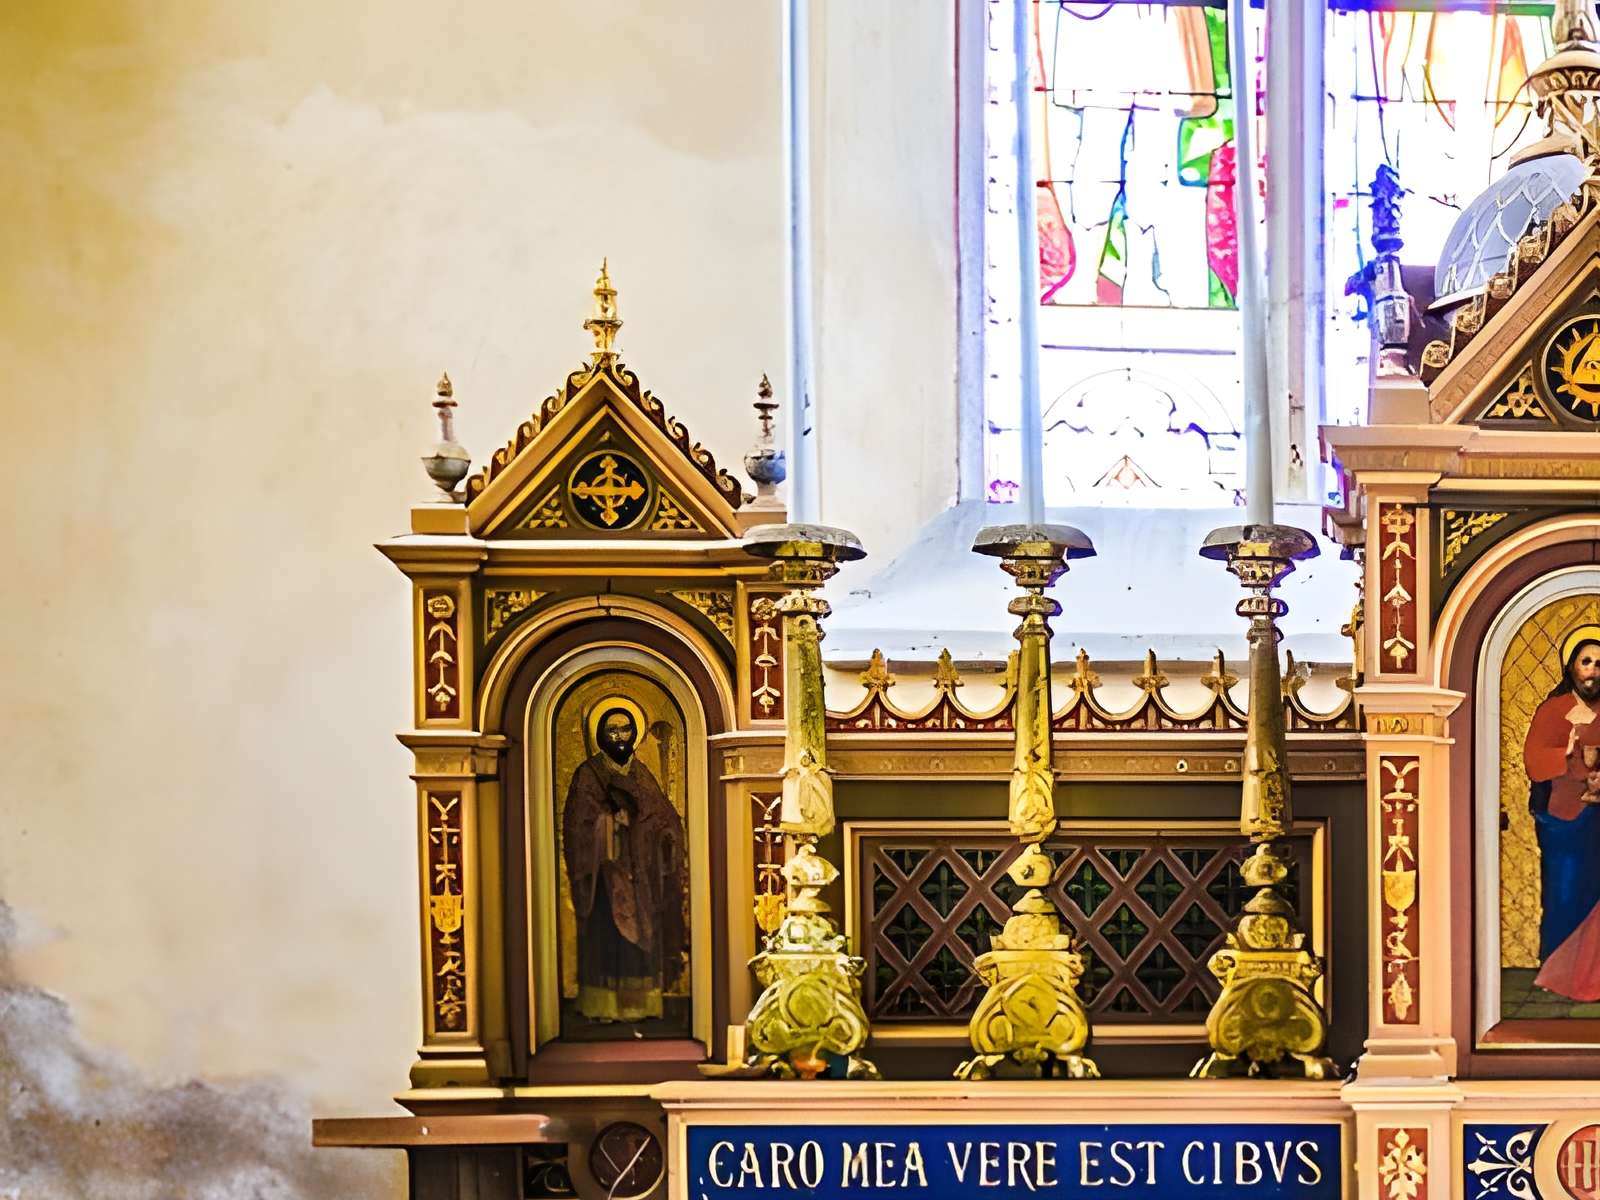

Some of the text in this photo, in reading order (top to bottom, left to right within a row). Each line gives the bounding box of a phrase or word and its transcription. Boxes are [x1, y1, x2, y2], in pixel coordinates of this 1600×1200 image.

[708, 1140, 1322, 1191] CARO MEA VERE EST CIBVS
